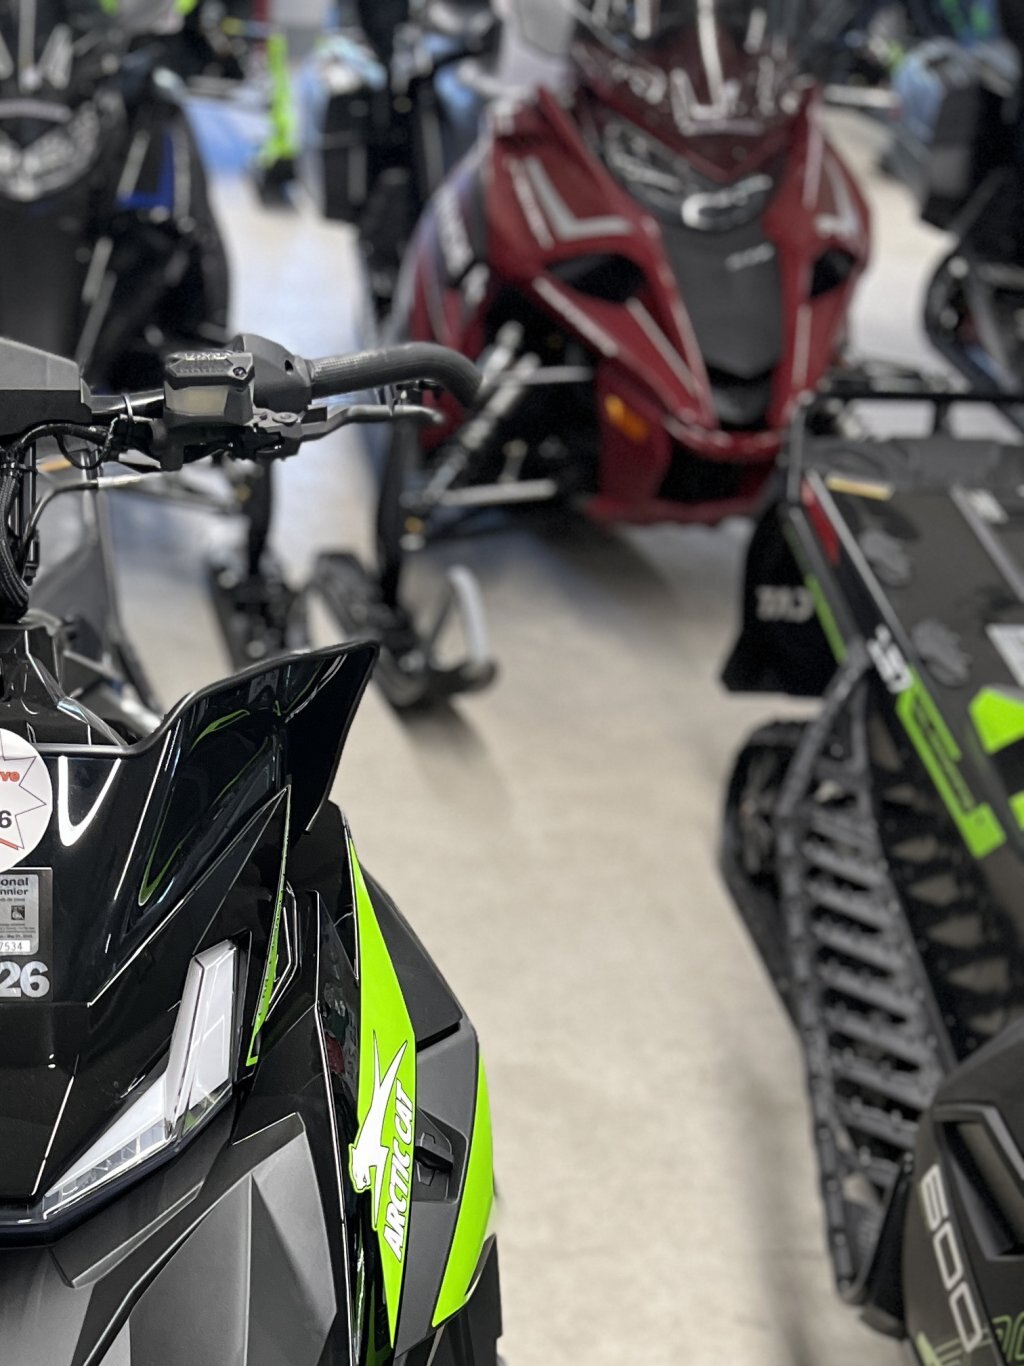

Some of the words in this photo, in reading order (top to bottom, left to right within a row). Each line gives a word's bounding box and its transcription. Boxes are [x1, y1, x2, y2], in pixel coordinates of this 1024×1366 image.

[394, 1077, 413, 1145] CAT
[383, 1136, 411, 1263] ARCTIC
[919, 1163, 983, 1355] 600
